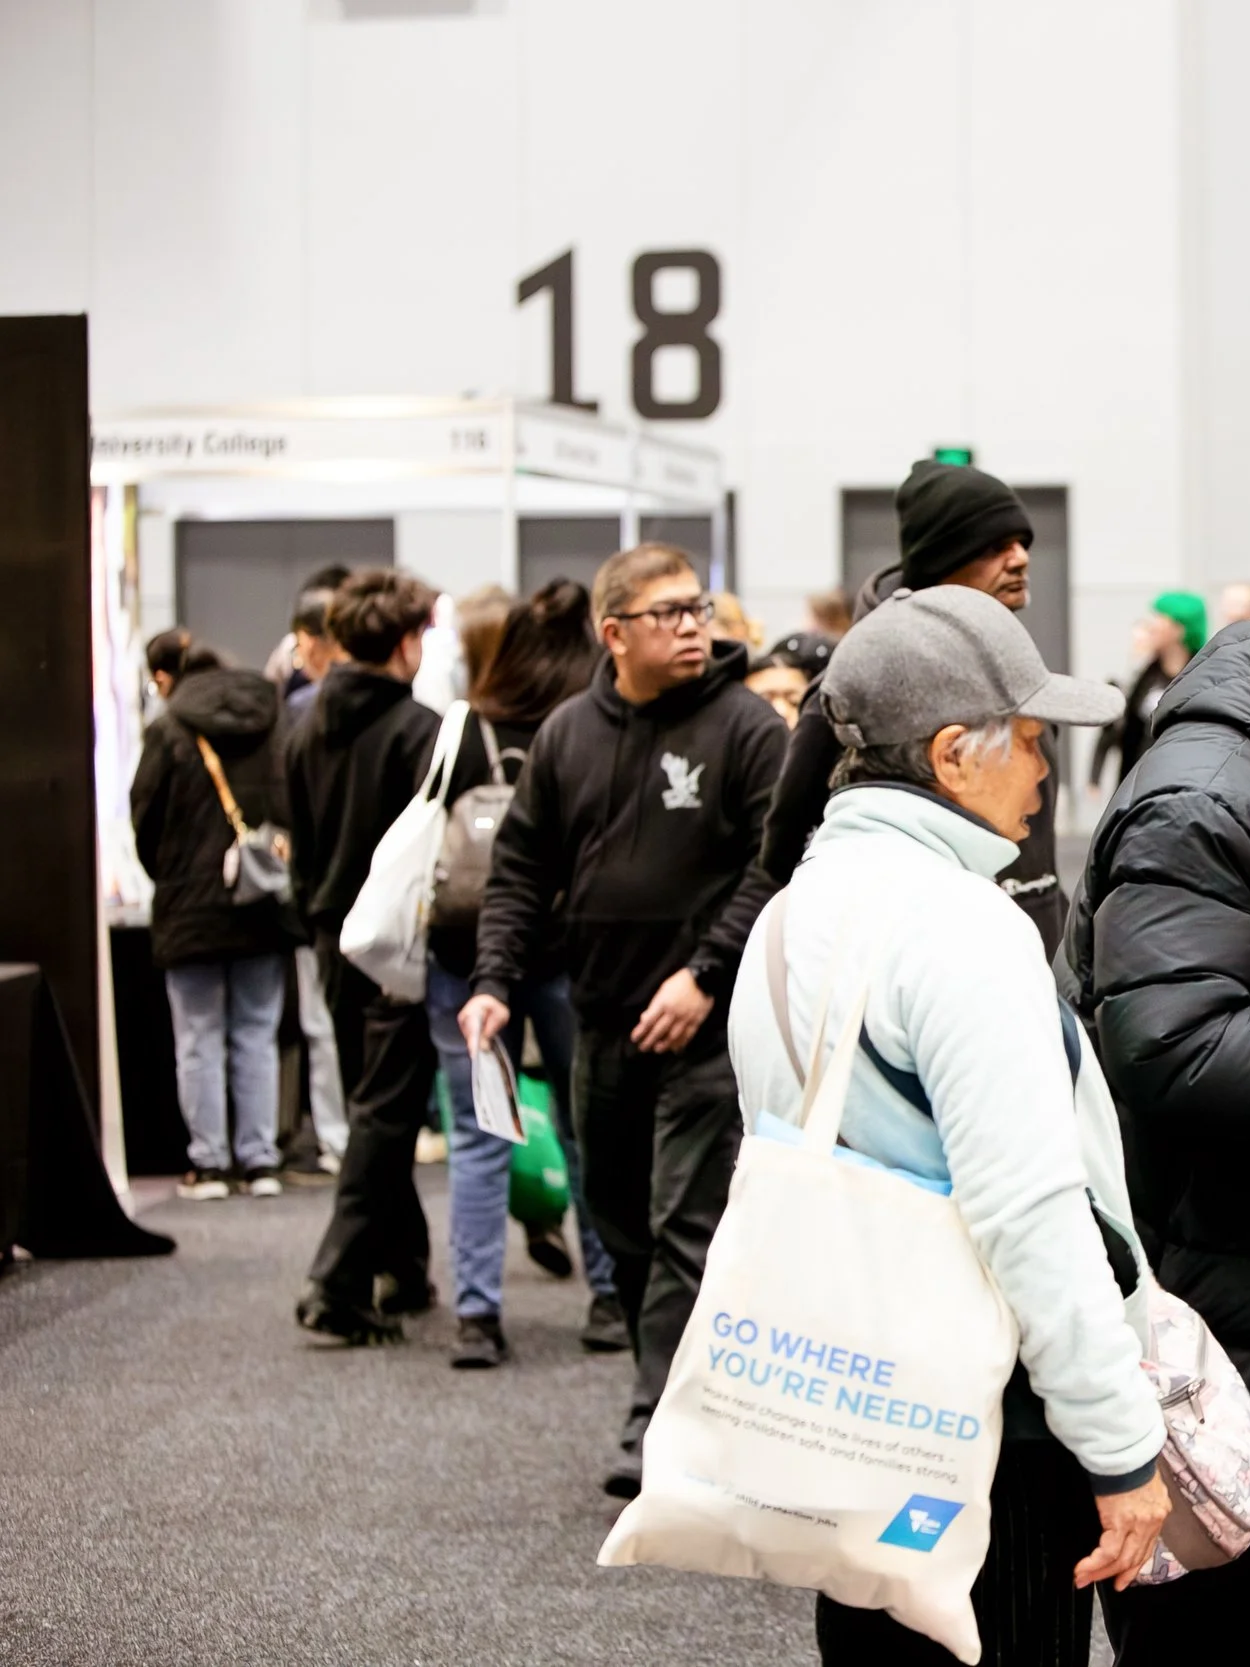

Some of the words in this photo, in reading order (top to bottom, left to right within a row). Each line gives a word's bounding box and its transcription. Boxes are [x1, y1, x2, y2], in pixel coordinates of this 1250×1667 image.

[517, 249, 722, 420] 18
[91, 432, 194, 457] niversity
[203, 430, 287, 458] College
[713, 1311, 759, 1345] GO
[770, 1327, 896, 1387] WHERE
[708, 1344, 829, 1406] YOU'RE
[835, 1385, 980, 1441] NEEDED
[743, 1419, 796, 1442] children
[799, 1437, 826, 1452] safe
[829, 1445, 856, 1462] and
[858, 1451, 912, 1474] families
[758, 1406, 806, 1428] change
[811, 1421, 824, 1433] to
[827, 1426, 848, 1440] the
[851, 1432, 881, 1449] lives
[884, 1441, 899, 1452] of
[902, 1445, 944, 1463] others
